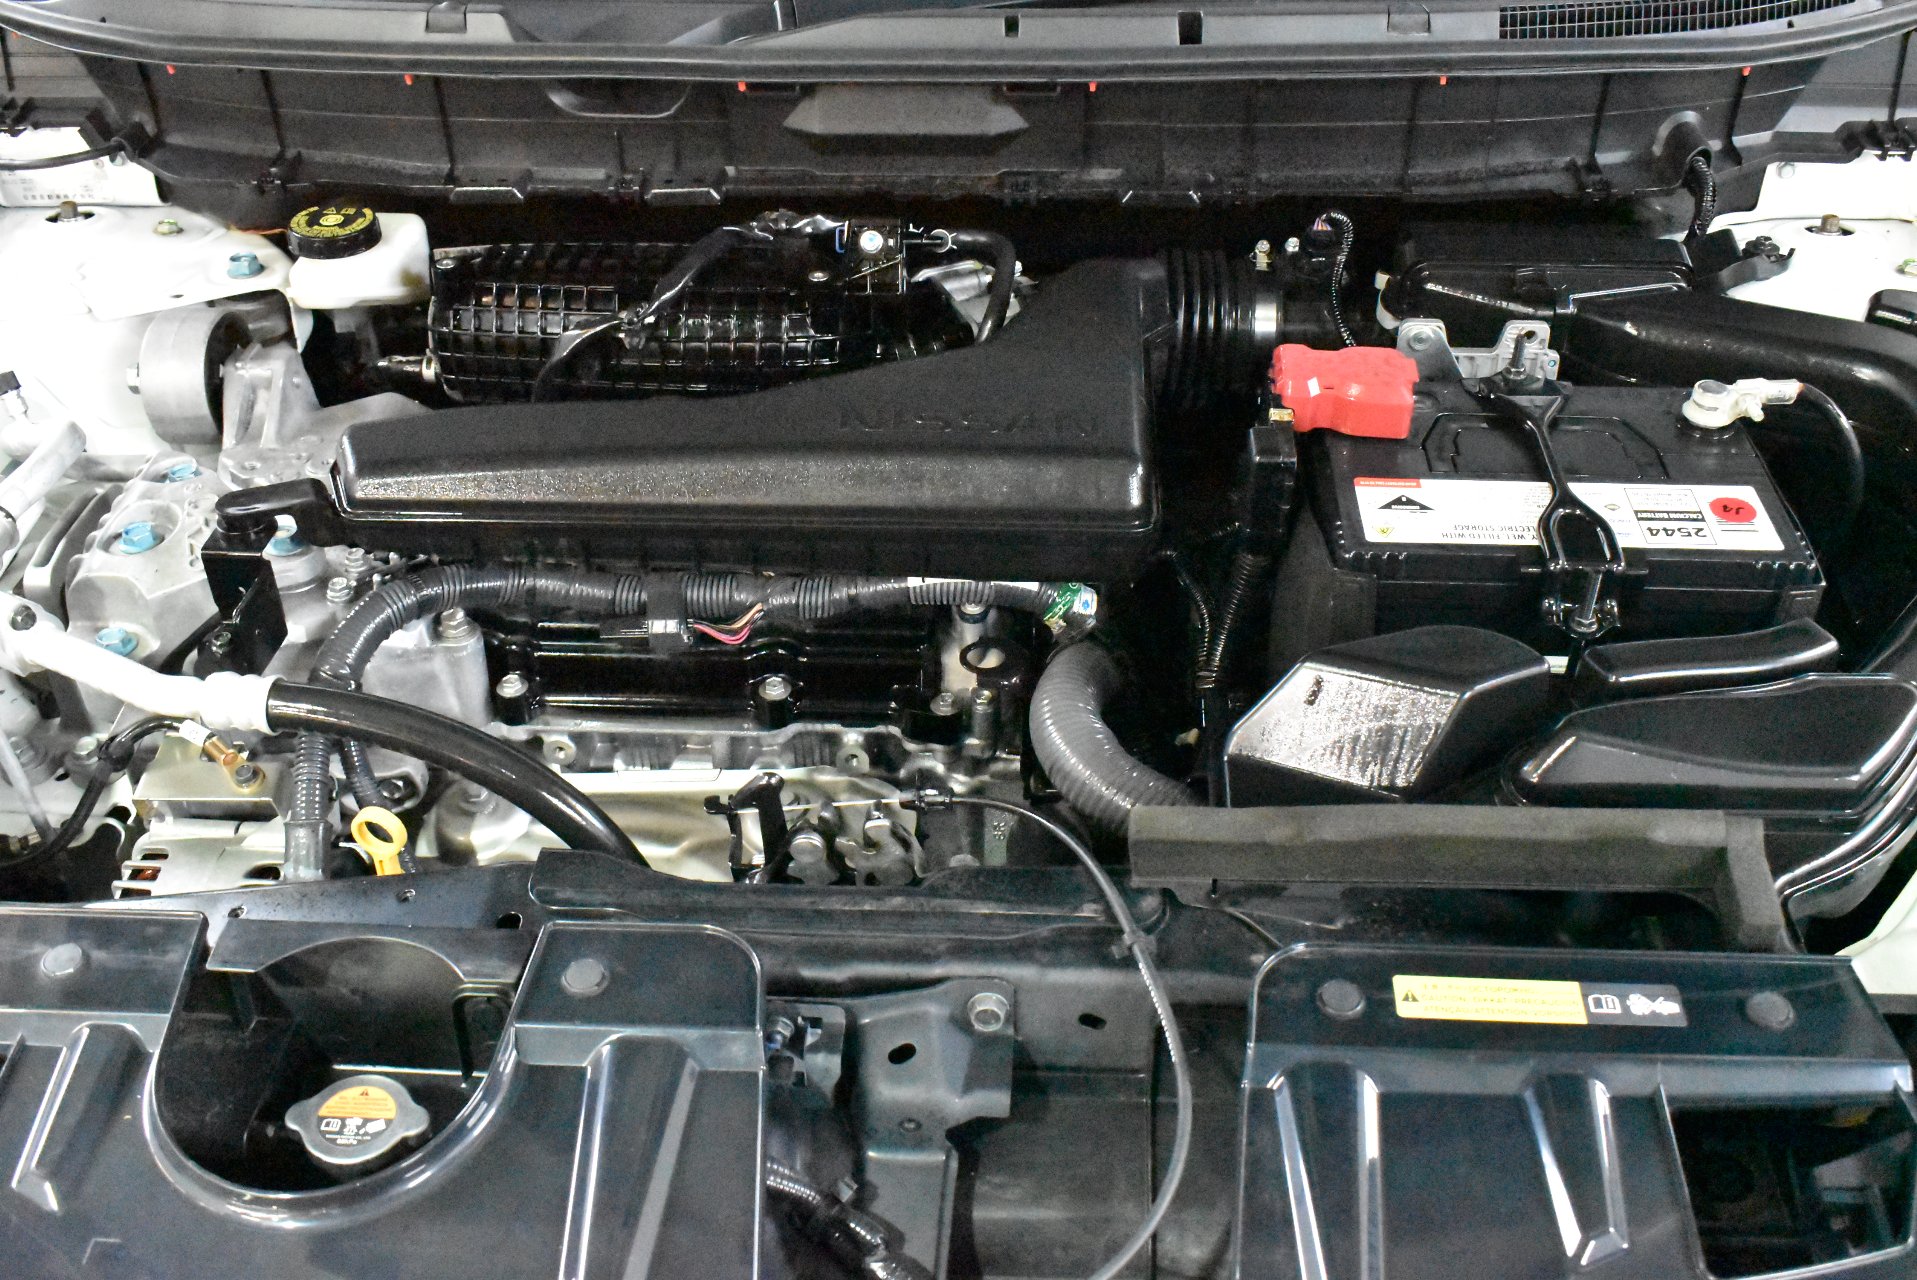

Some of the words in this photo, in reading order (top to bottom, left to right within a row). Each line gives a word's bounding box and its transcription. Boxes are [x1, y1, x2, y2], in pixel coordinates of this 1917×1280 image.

[1453, 524, 1495, 532] STORAGE
[1646, 526, 1708, 538] 2544
[1441, 532, 1467, 540] WITH
[1469, 532, 1500, 540] FILLED
